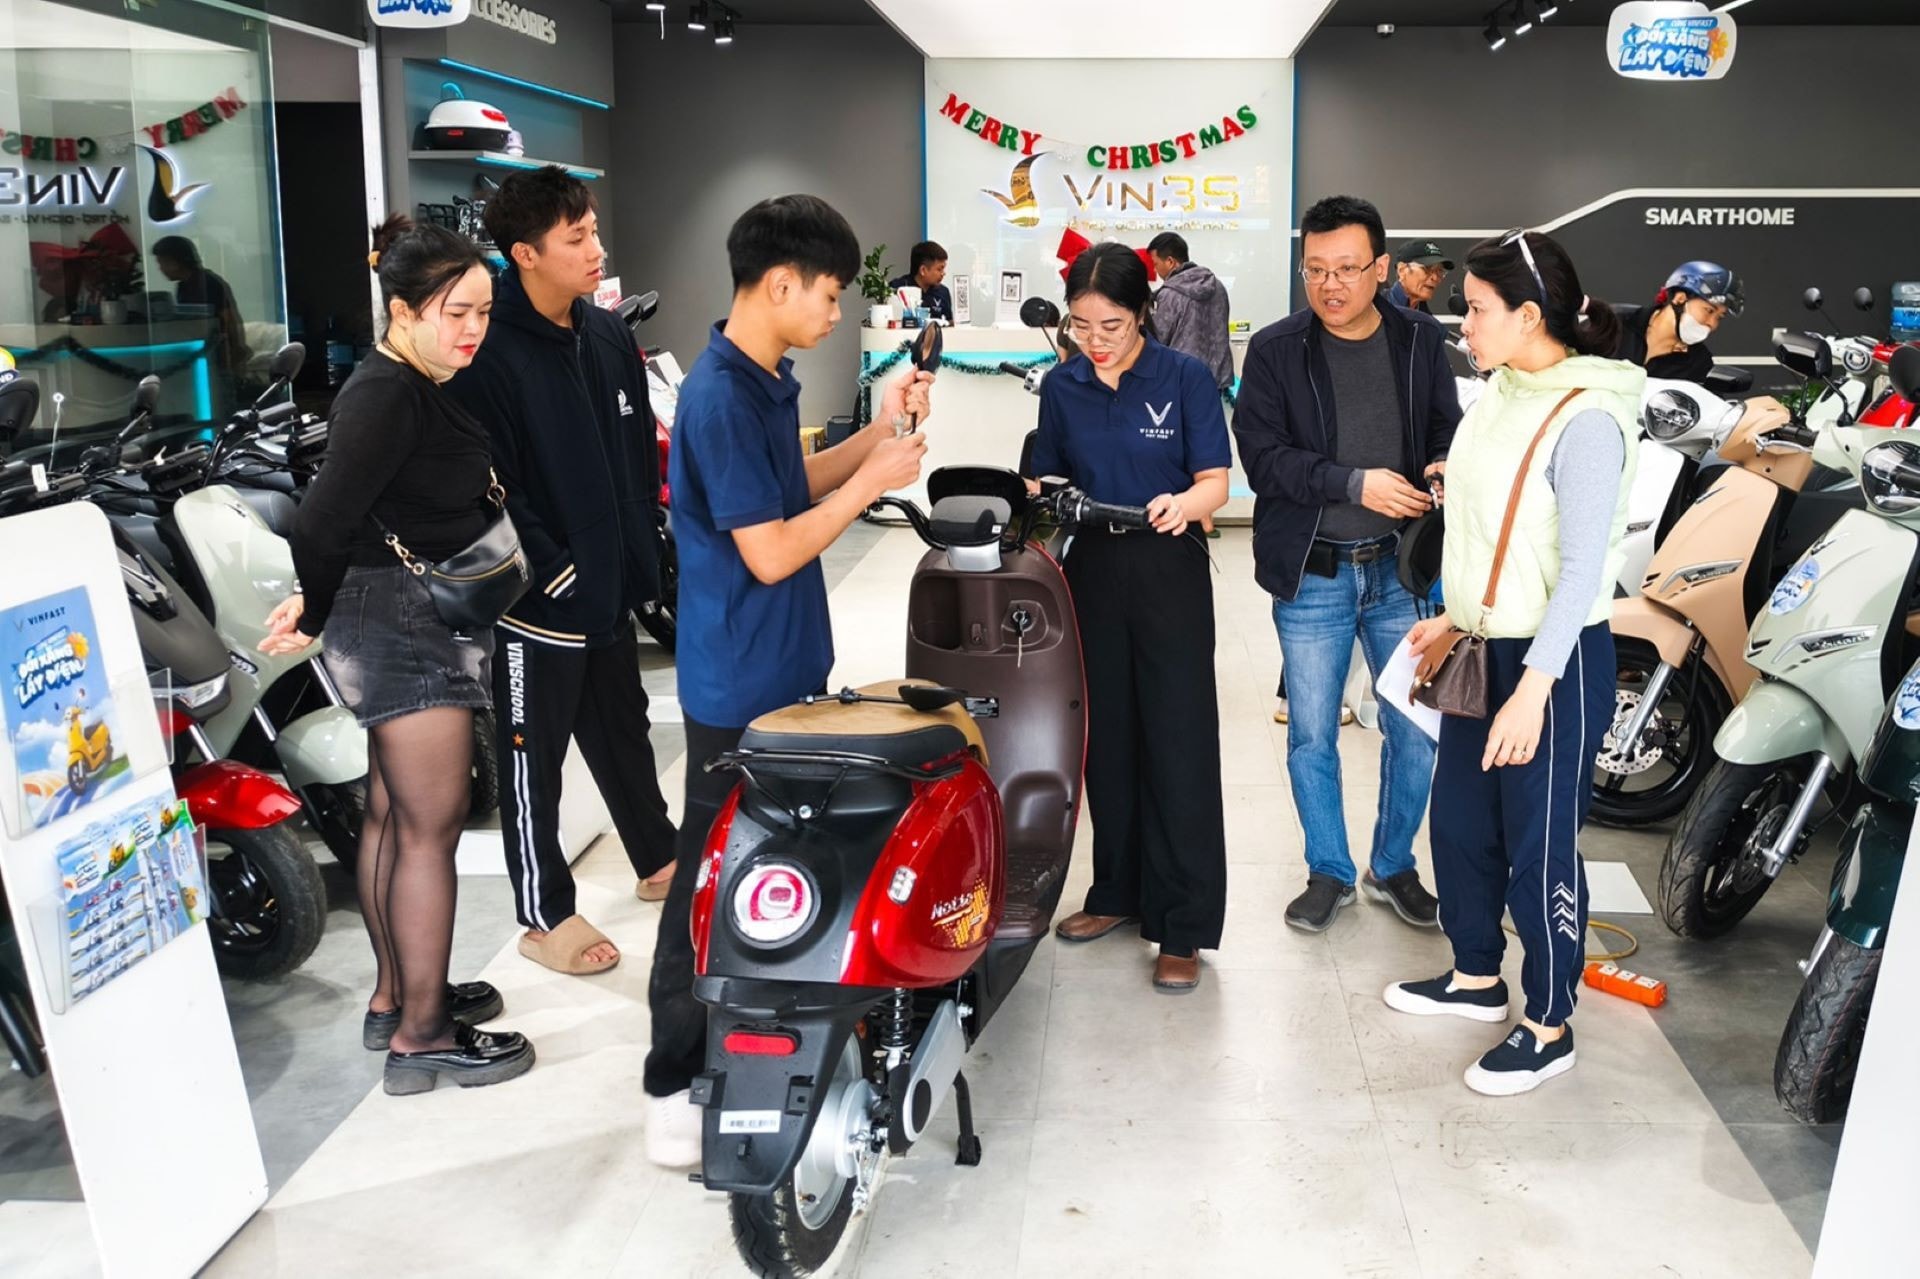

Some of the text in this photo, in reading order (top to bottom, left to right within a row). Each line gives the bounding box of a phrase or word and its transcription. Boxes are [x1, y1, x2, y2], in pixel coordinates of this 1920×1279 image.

[472, 0, 557, 44] CCESSORIES
[939, 93, 1257, 170] MERRY CHRISTMAS
[1063, 174, 1241, 213] VIN3S
[1645, 207, 1795, 225] SMARTHOME
[28, 607, 66, 625] VINFAST
[506, 642, 524, 726] VINSCHOOL
